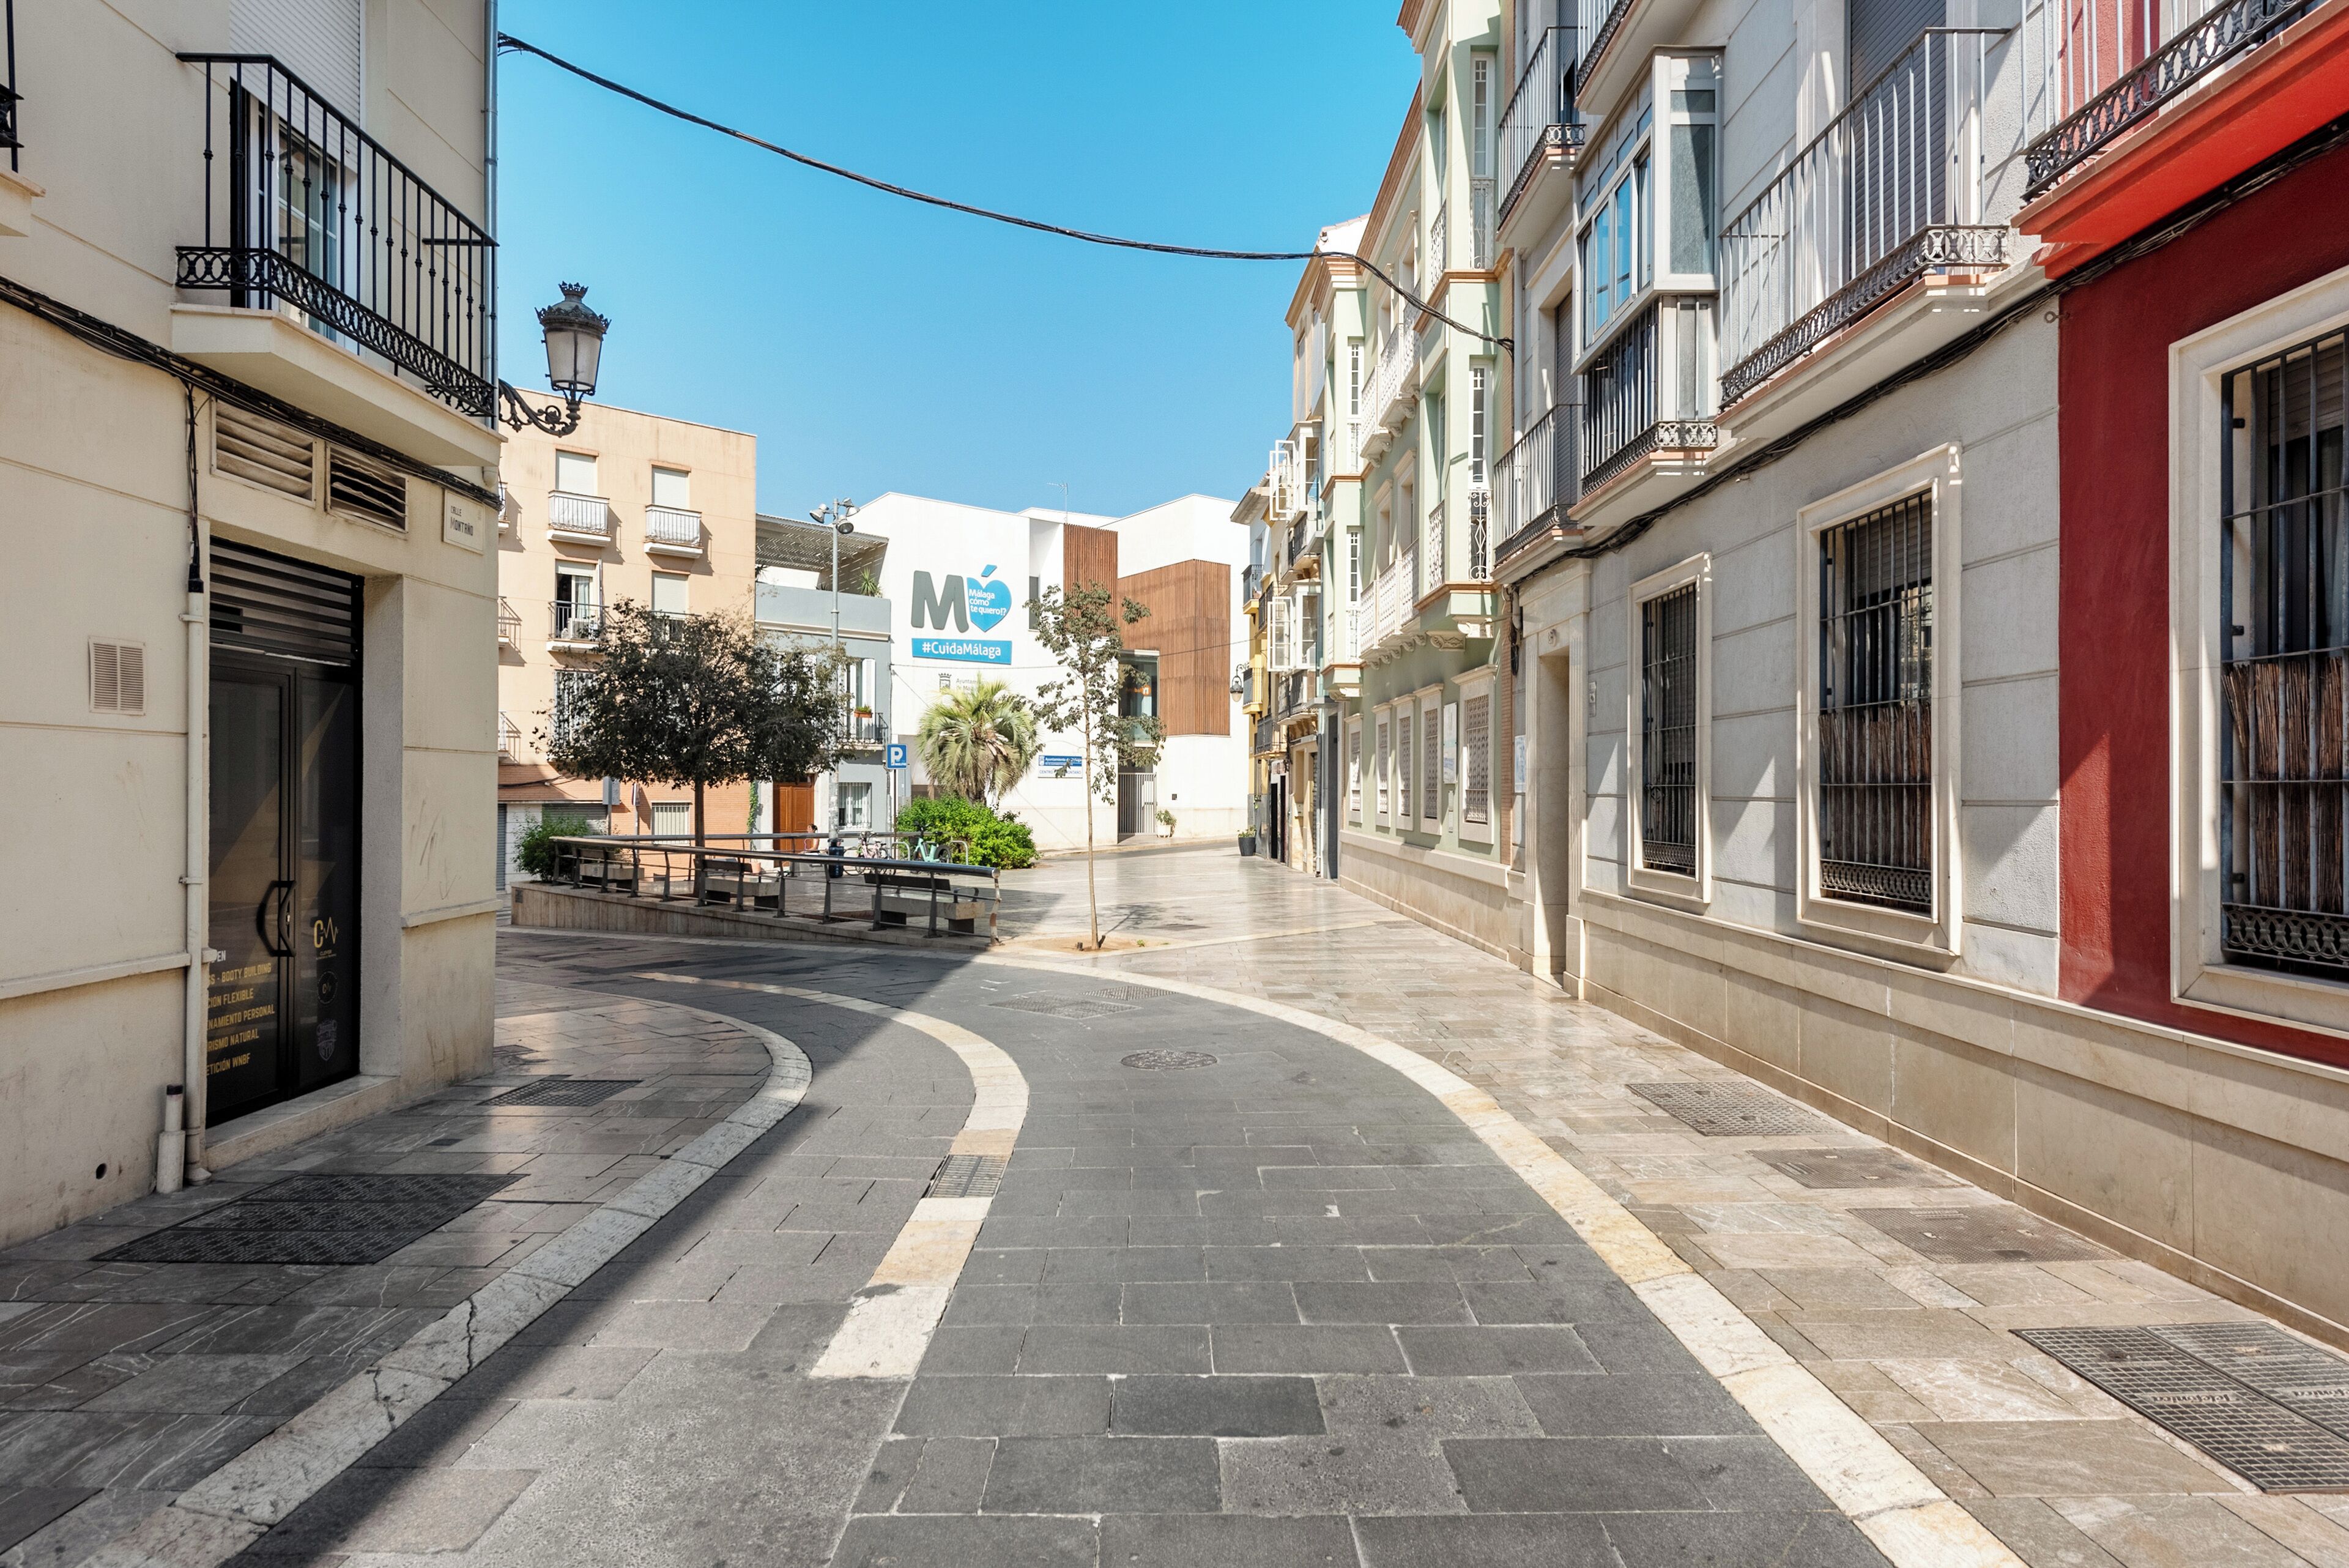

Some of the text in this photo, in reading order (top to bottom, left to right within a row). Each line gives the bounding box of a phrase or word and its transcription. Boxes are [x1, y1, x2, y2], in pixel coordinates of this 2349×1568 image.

[450, 505, 461, 516] CALLE
[450, 516, 473, 536] MONTAÑO
[969, 589, 995, 600] Málaga
[969, 597, 990, 607] cómo
[970, 604, 978, 613] te
[922, 642, 1001, 659] #CuidaMálaga
[891, 747, 904, 765] P
[221, 968, 242, 983] BOOTY
[244, 962, 272, 978] BUILDING
[223, 988, 254, 1005] FLEXIBLE
[208, 1004, 275, 1030] NAMIENTO PERSONAL
[208, 1028, 259, 1052] RISMO NATURAL
[207, 1052, 250, 1075] ETICIÓN WNBF
